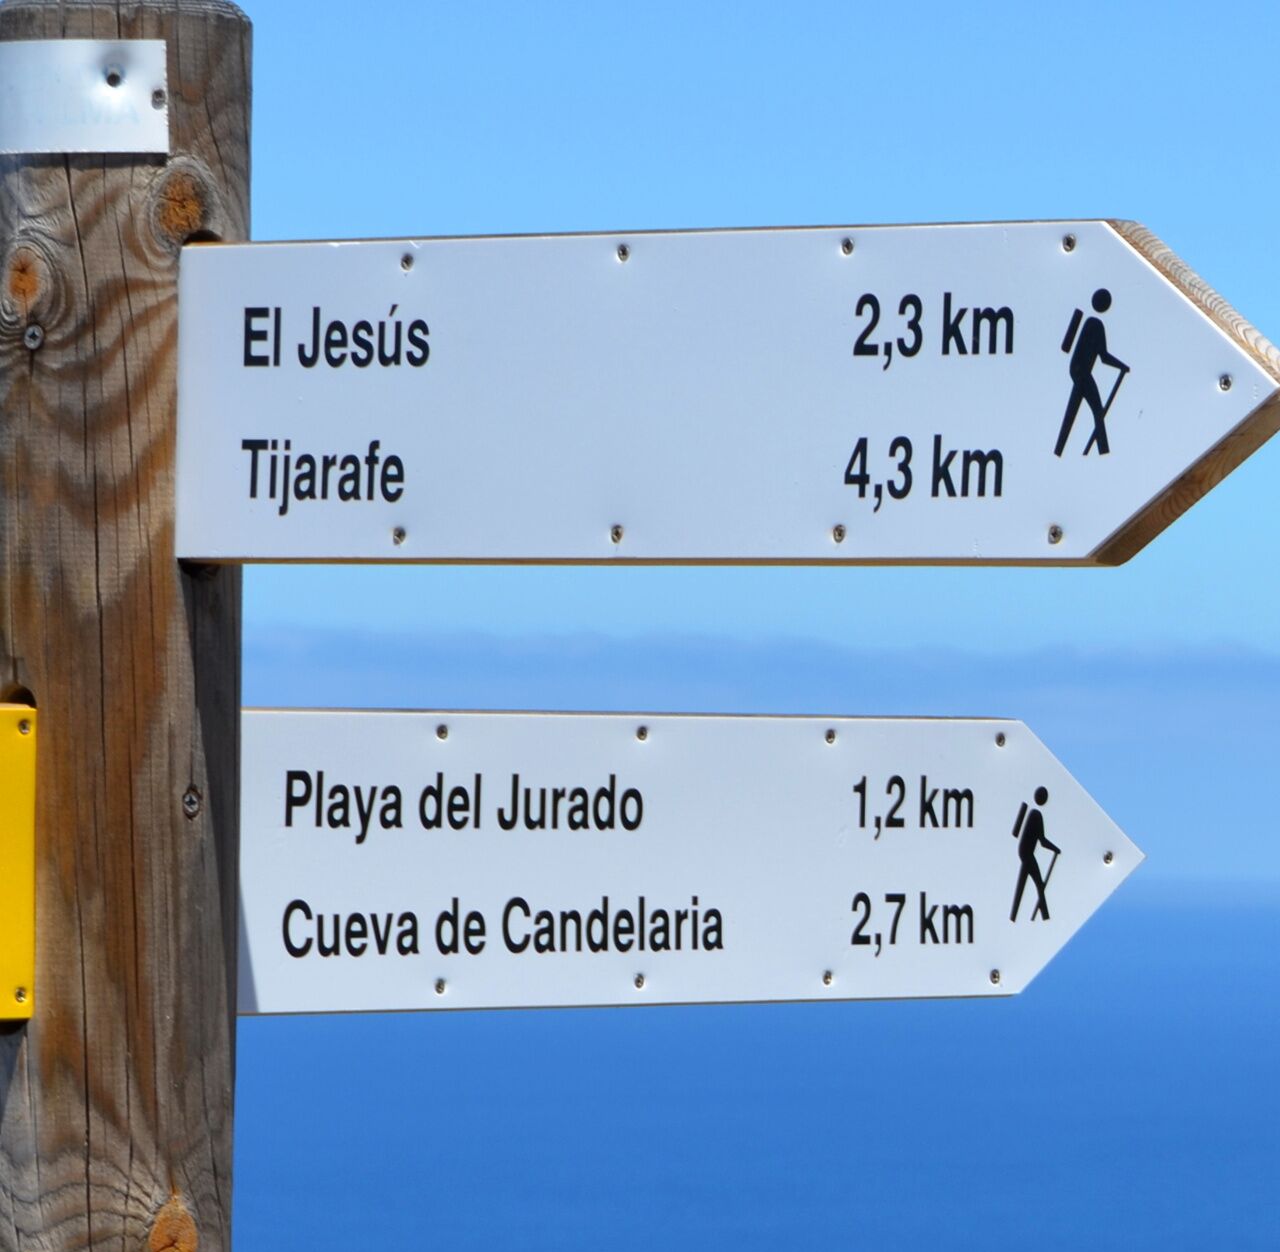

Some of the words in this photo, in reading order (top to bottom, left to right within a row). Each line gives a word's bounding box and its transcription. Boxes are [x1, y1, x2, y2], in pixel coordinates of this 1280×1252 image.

[242, 305, 283, 368] El
[296, 302, 431, 370] Jesús
[852, 292, 924, 372] 2,3
[940, 291, 1015, 357] km
[240, 438, 406, 517] Tijarafe
[843, 435, 914, 514] 4,3
[930, 433, 1005, 499] km
[284, 769, 404, 846] Playa
[417, 771, 483, 832] del
[496, 772, 645, 832] Jurado
[852, 774, 907, 841] 1,2
[918, 774, 975, 829] km
[281, 898, 421, 959] Cueva
[434, 896, 487, 957] de
[501, 894, 725, 955] Candelaria
[850, 891, 907, 958] 2,7
[919, 890, 975, 946] km
